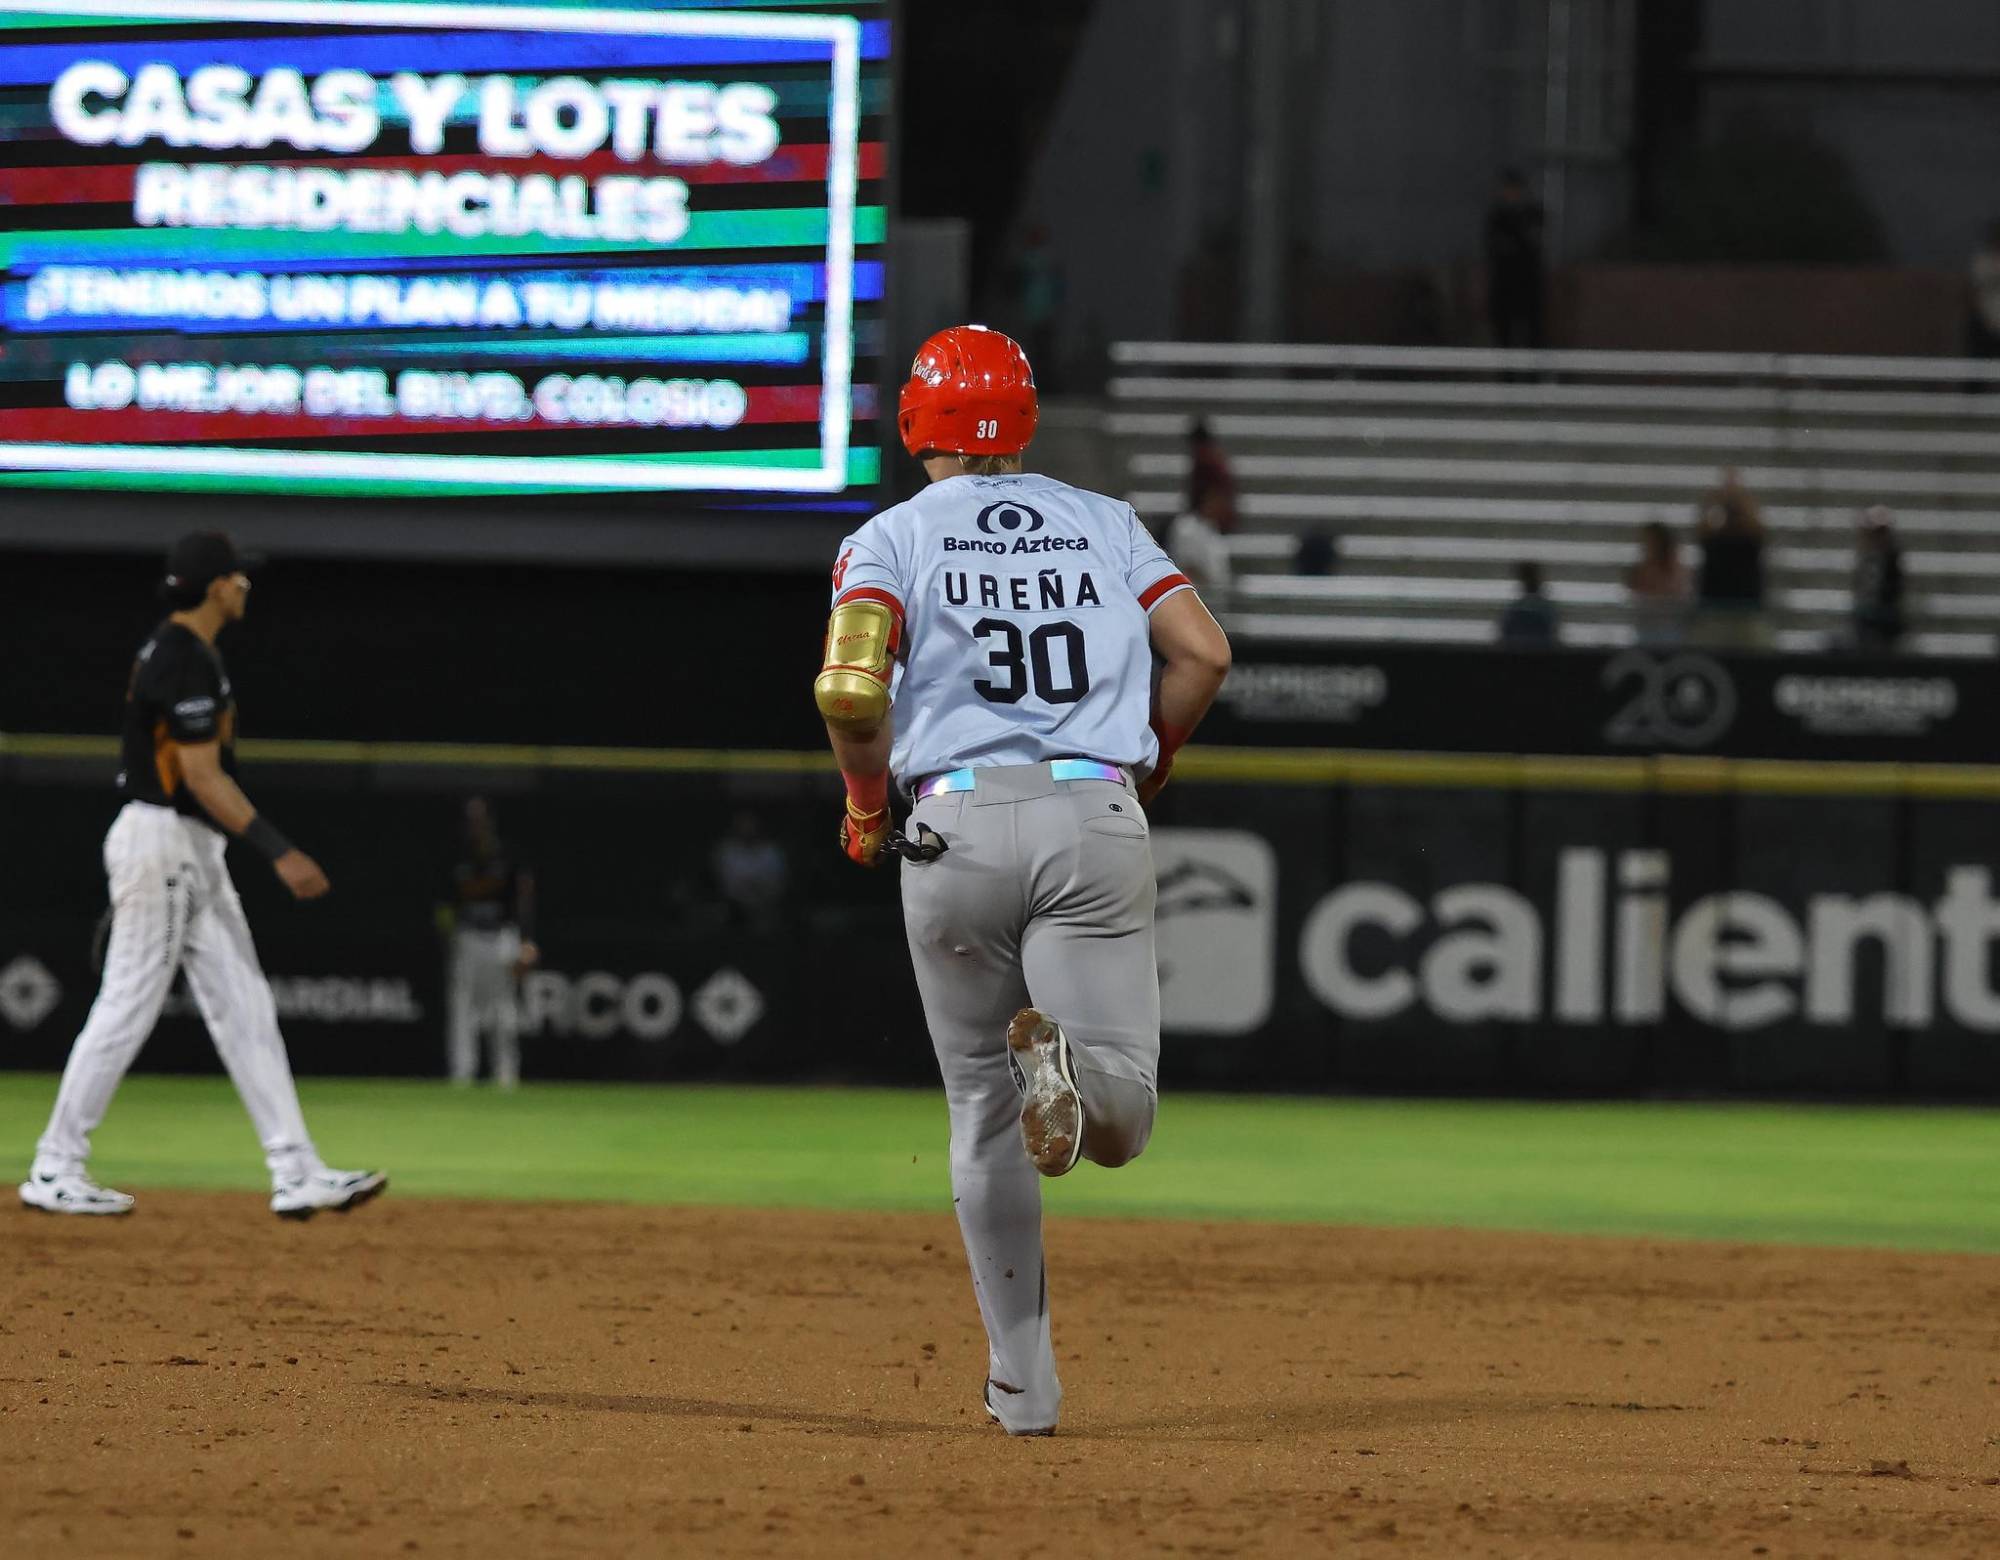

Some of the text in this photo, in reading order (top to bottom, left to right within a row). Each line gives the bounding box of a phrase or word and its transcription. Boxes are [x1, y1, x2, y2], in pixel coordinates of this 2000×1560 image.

[49, 59, 781, 166] CASAS Y LOTES
[133, 161, 690, 243] RESIDENCIALES
[65, 359, 137, 410] LO
[533, 372, 747, 429] COLOSIO
[976, 419, 998, 439] 30
[943, 535, 1089, 555] Banco Azteca
[945, 568, 1101, 610] UREÑA
[972, 617, 1090, 704] 30
